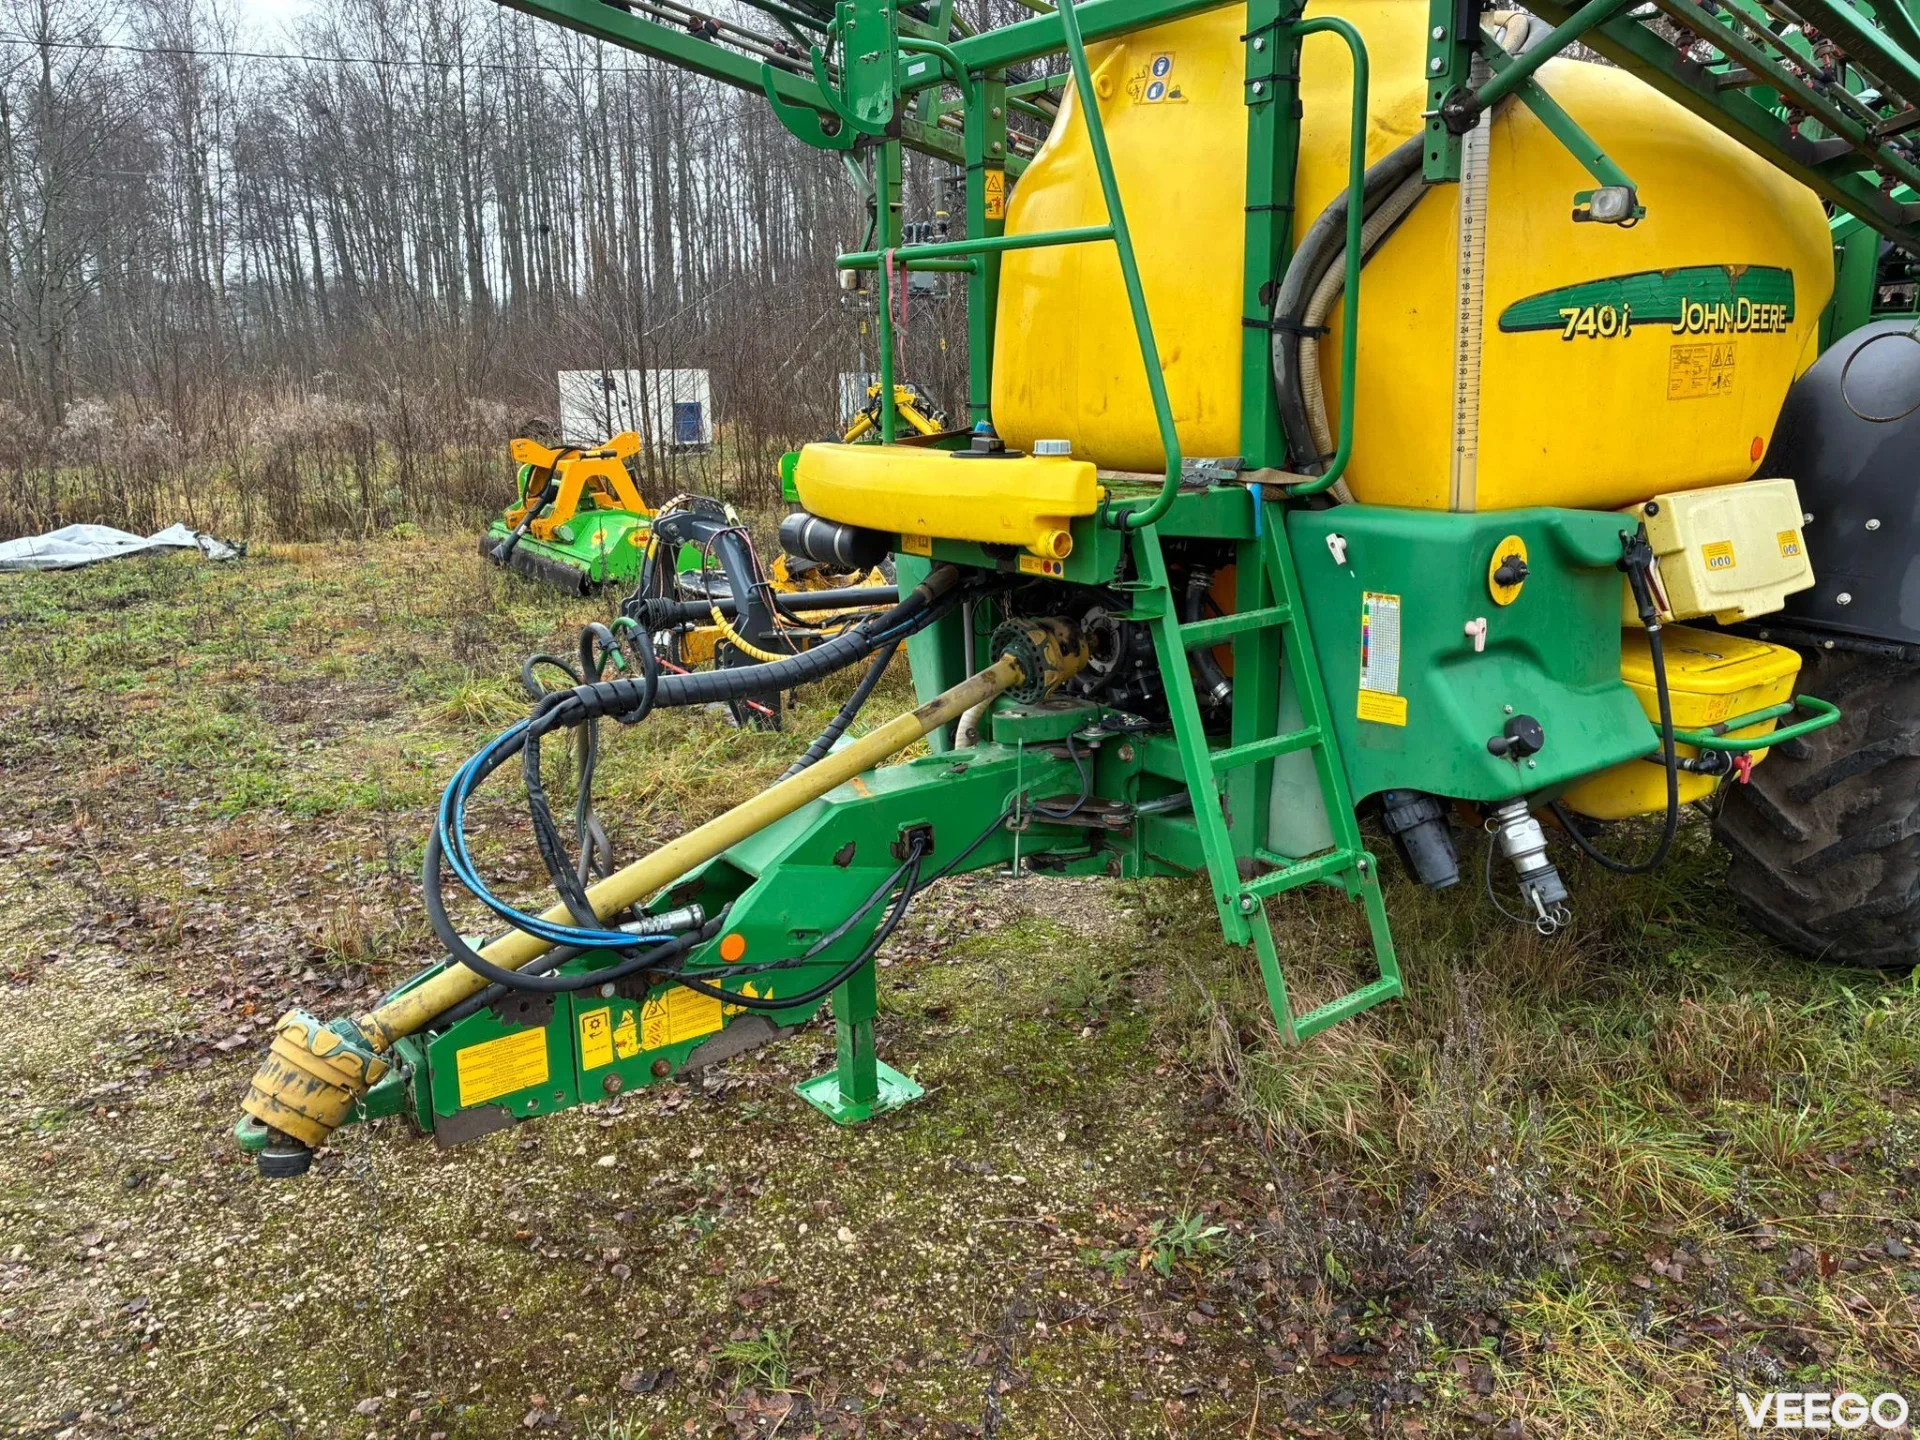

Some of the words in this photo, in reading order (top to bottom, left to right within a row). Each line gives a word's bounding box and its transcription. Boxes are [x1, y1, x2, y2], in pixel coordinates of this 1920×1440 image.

[1465, 196, 1470, 204] 8
[1464, 216, 1473, 225] 10
[1463, 234, 1472, 242] 12
[1671, 297, 1735, 333] JOHN
[1737, 297, 1787, 331] DEERE
[1559, 302, 1632, 339] 740i
